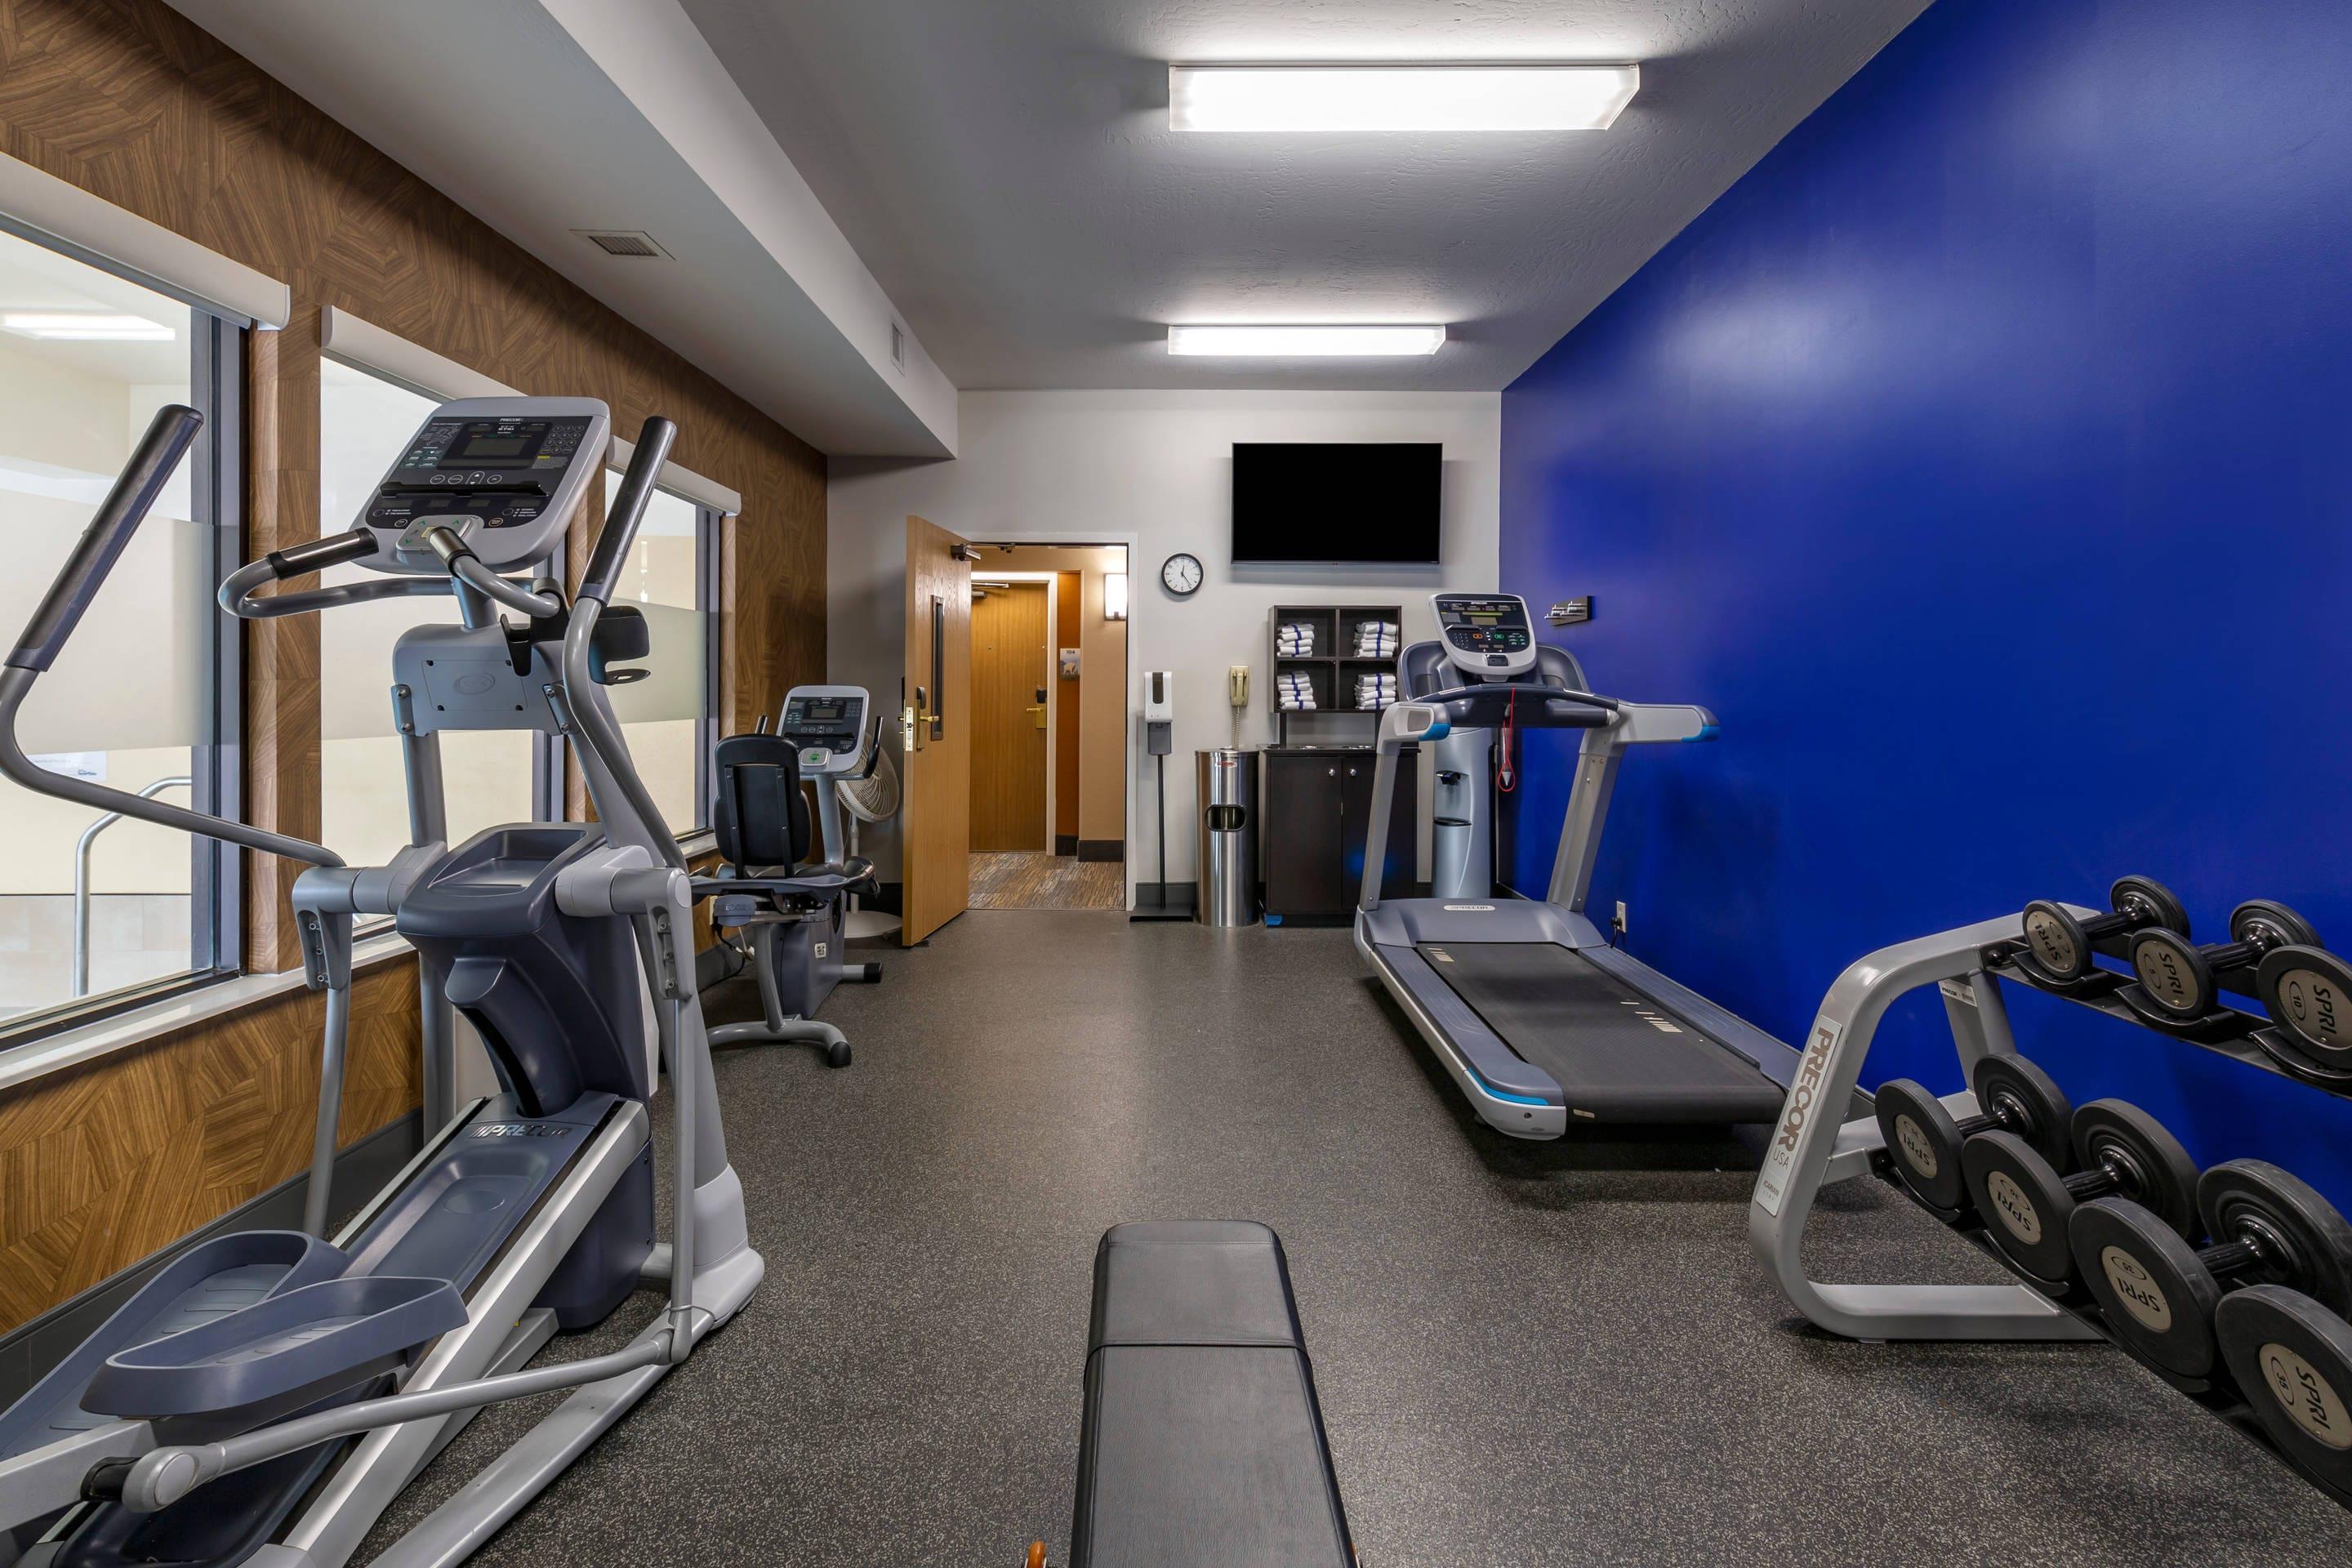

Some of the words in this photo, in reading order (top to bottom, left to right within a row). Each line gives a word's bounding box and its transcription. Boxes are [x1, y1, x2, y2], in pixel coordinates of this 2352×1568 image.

[2034, 924, 2062, 962] SPRI
[2158, 951, 2185, 996] SPRI
[2293, 995, 2302, 1009] 10
[2313, 985, 2337, 1035] SPRI
[1777, 1026, 1834, 1152] PRECOR
[1773, 1147, 1790, 1170] USA
[1904, 1133, 1930, 1165] SPRI
[1763, 1179, 1780, 1197] ICARIAN
[1998, 1190, 2032, 1232] SPRI
[2122, 1261, 2136, 1274] 35
[2117, 1276, 2161, 1312] SPRI
[2276, 1372, 2289, 1390] 35
[2296, 1366, 2332, 1430] SPRI
